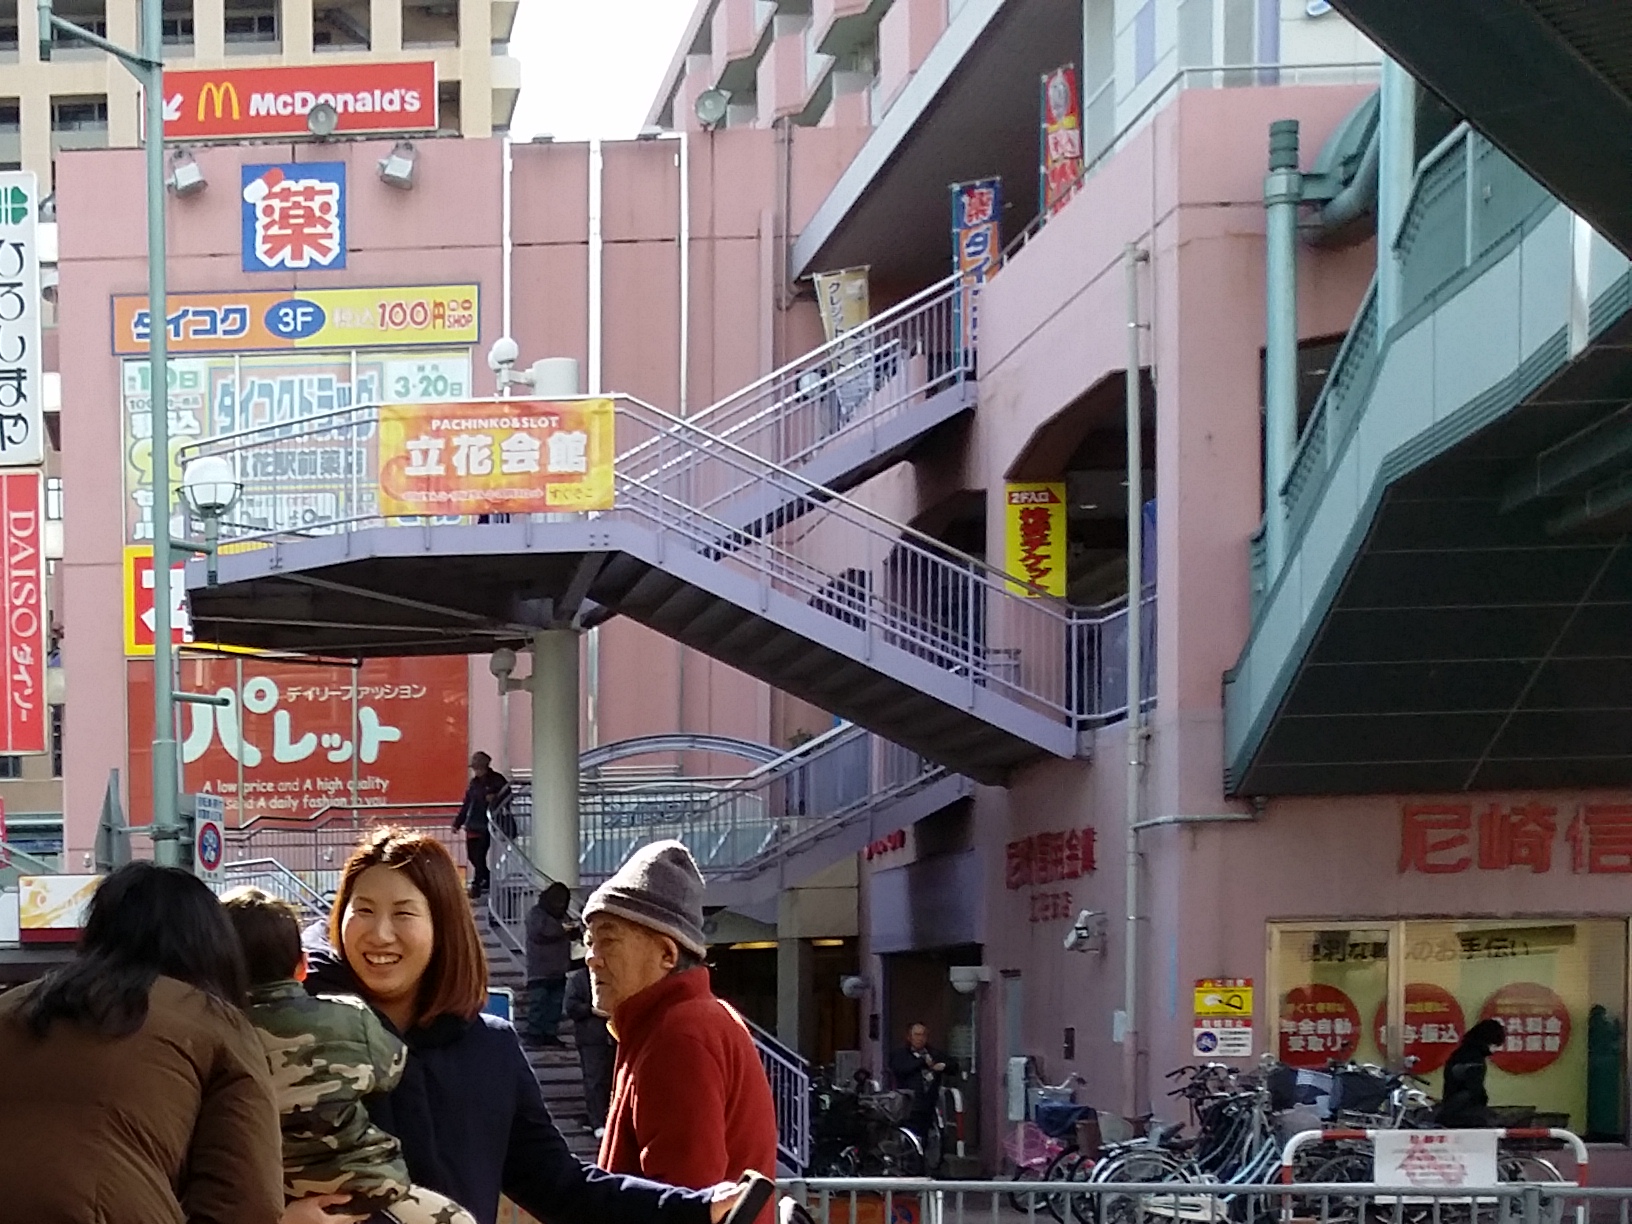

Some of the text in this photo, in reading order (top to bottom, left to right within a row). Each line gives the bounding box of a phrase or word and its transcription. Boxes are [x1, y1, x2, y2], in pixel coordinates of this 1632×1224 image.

[259, 184, 336, 263] 薬
[276, 306, 314, 333] 3F
[431, 417, 560, 430] PACHINKO&SLOT
[404, 431, 588, 477] 立花会館
[9, 510, 39, 722] DAISO ダイソー
[286, 685, 427, 703] デイリーファッション
[182, 676, 402, 767] パレット
[202, 780, 213, 793] A
[218, 779, 237, 793] low
[244, 781, 274, 796] price
[278, 779, 299, 792] and
[303, 779, 314, 791] A
[317, 776, 343, 795] high
[256, 796, 267, 809] A
[270, 794, 299, 812] daily
[303, 792, 347, 808] fashion
